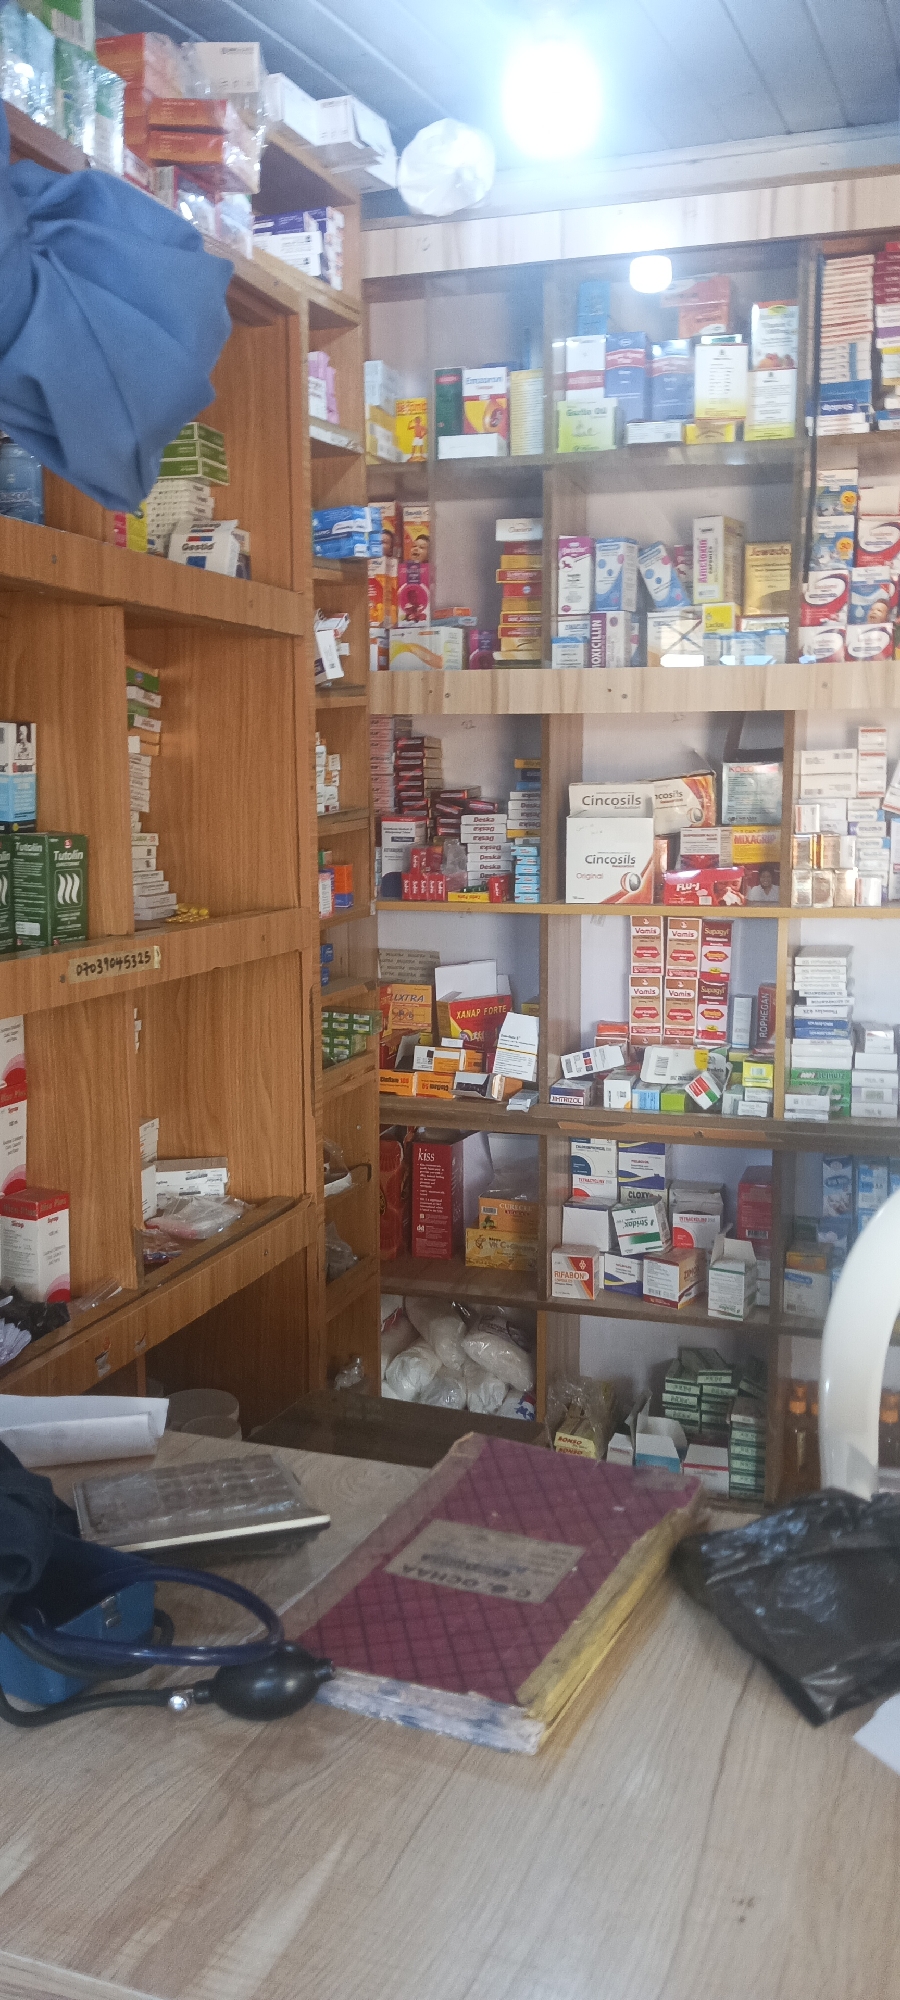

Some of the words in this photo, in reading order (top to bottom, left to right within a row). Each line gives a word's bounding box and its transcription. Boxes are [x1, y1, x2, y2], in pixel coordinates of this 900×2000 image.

[582, 794, 642, 807] Cincosils
[54, 850, 84, 861] Tutolin
[585, 854, 636, 865] Cincosils
[576, 872, 603, 882] Original
[635, 927, 657, 935] Vamis
[672, 930, 695, 938] Vamis
[705, 928, 729, 937] Supagyl
[634, 988, 657, 996] Vamis
[701, 986, 726, 995] Supagyl
[456, 1009, 481, 1020] XANAP
[484, 1004, 507, 1015] FORTE
[418, 1148, 435, 1162] kiss
[624, 1218, 649, 1228] Stridox
[554, 1270, 585, 1280] RIFABON
